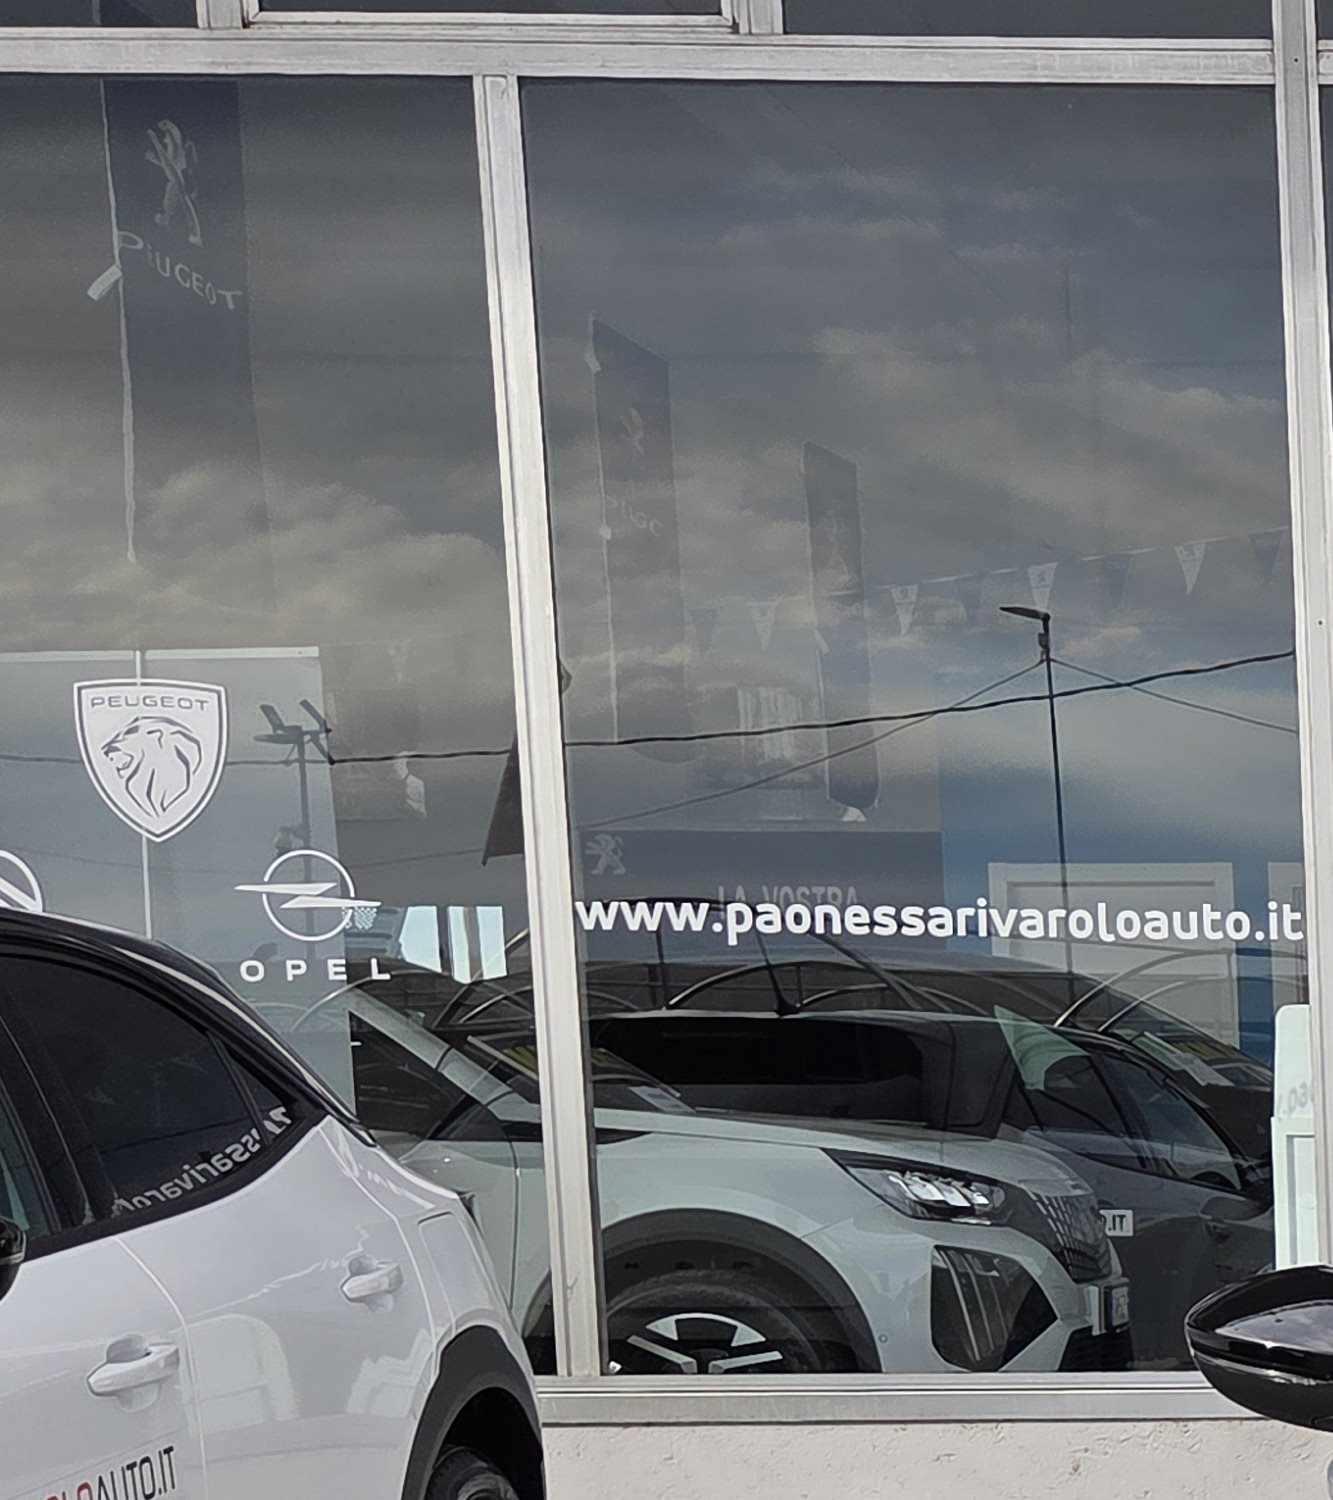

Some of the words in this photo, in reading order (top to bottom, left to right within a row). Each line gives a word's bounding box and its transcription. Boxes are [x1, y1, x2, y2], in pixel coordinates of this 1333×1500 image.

[90, 694, 210, 712] PEUGEOT
[575, 897, 1305, 946] www.paonessarivaroloauto.it
[239, 957, 392, 983] OPEL
